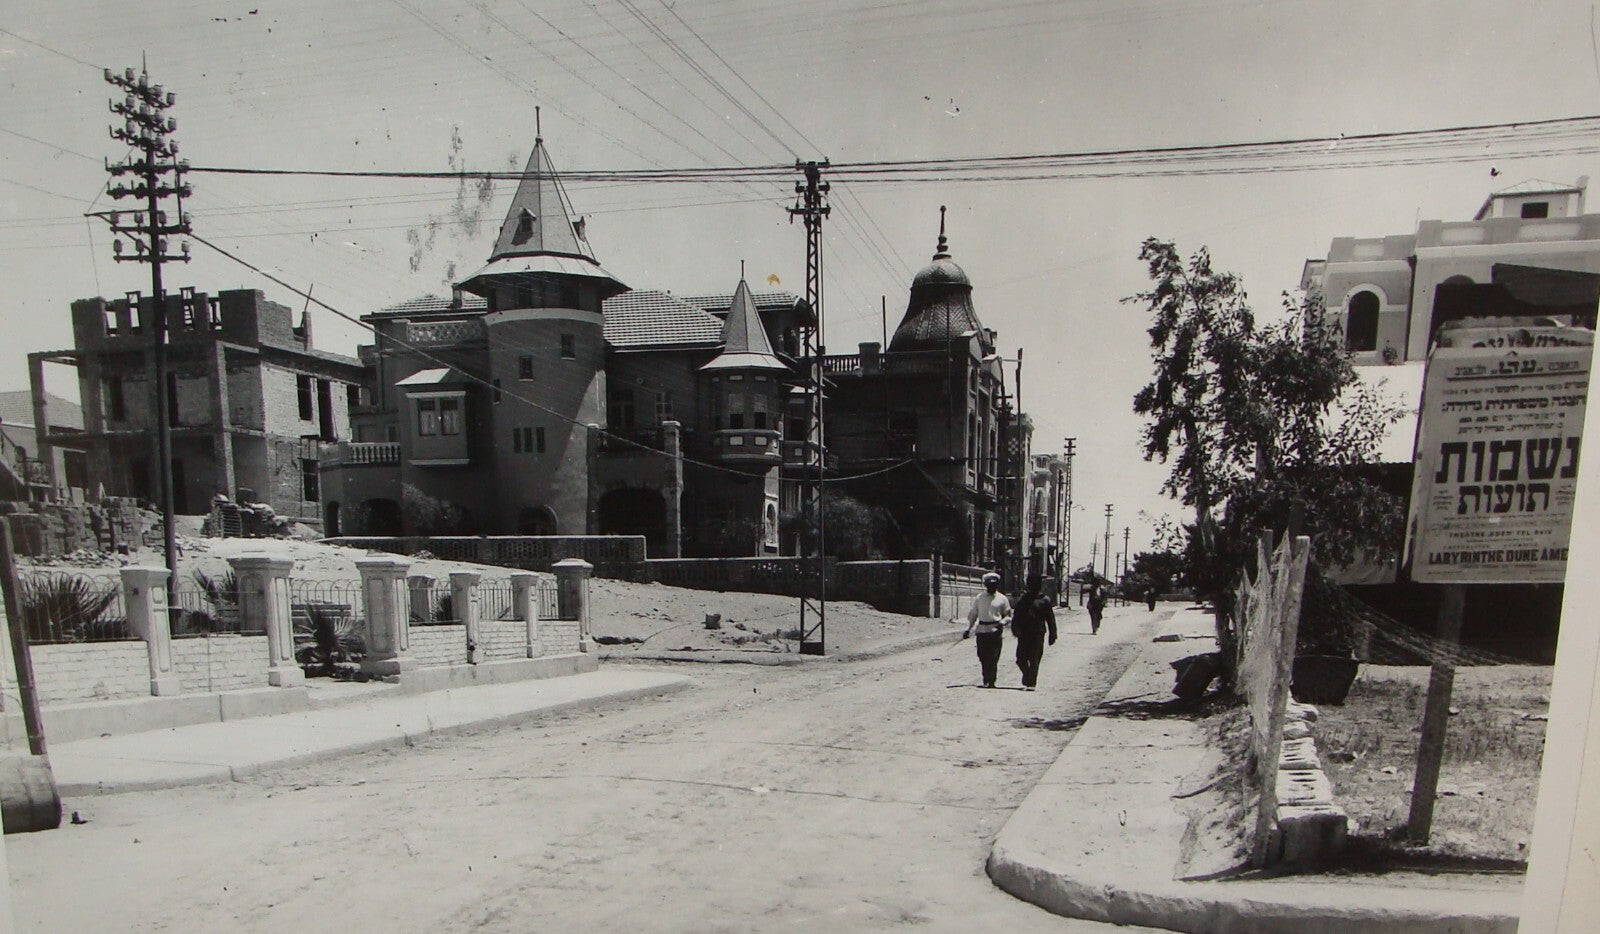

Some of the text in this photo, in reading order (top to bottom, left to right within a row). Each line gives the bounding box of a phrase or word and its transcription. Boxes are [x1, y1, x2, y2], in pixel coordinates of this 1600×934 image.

[1435, 436, 1580, 483] נשמות
[1457, 483, 1550, 514] תועות
[1428, 550, 1504, 565] LABYRINTHE
